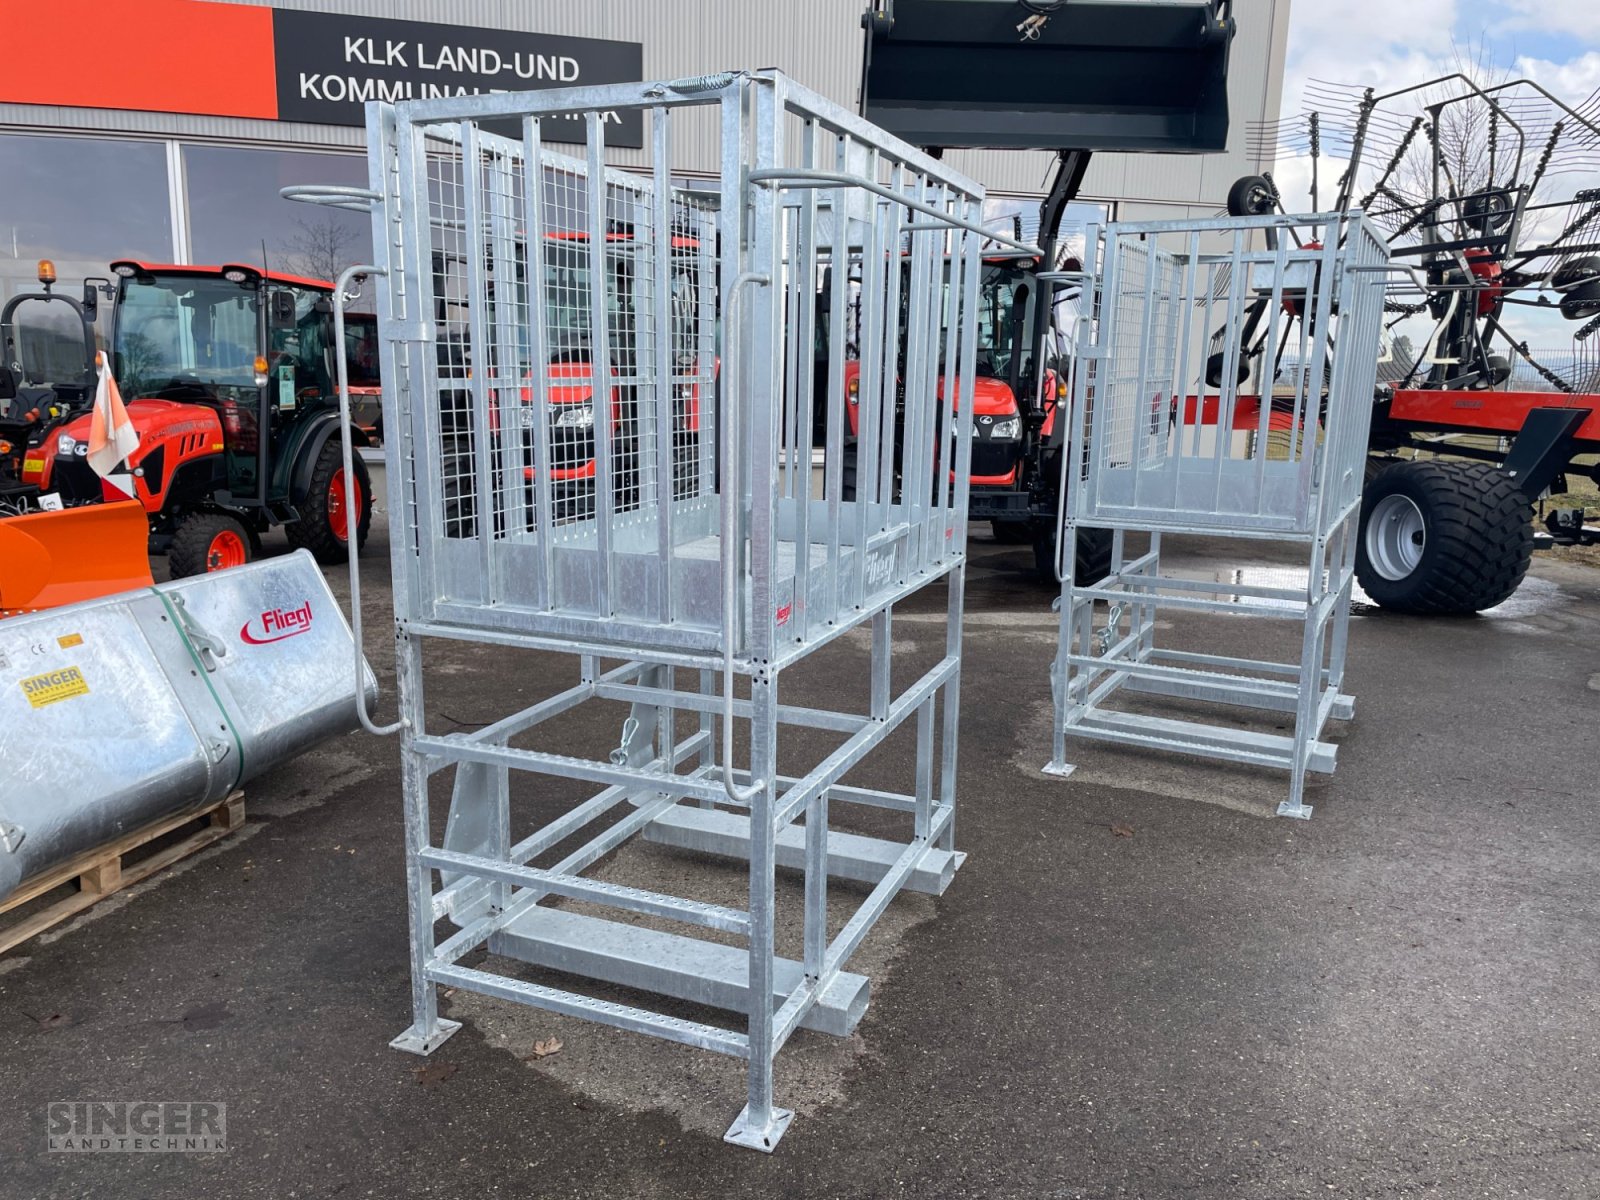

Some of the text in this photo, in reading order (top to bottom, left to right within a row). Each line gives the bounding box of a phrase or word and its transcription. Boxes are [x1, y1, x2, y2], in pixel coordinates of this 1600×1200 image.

[345, 36, 579, 82] KLK LAND-UND
[261, 600, 313, 634] Fliegl
[23, 668, 81, 693] SINGER
